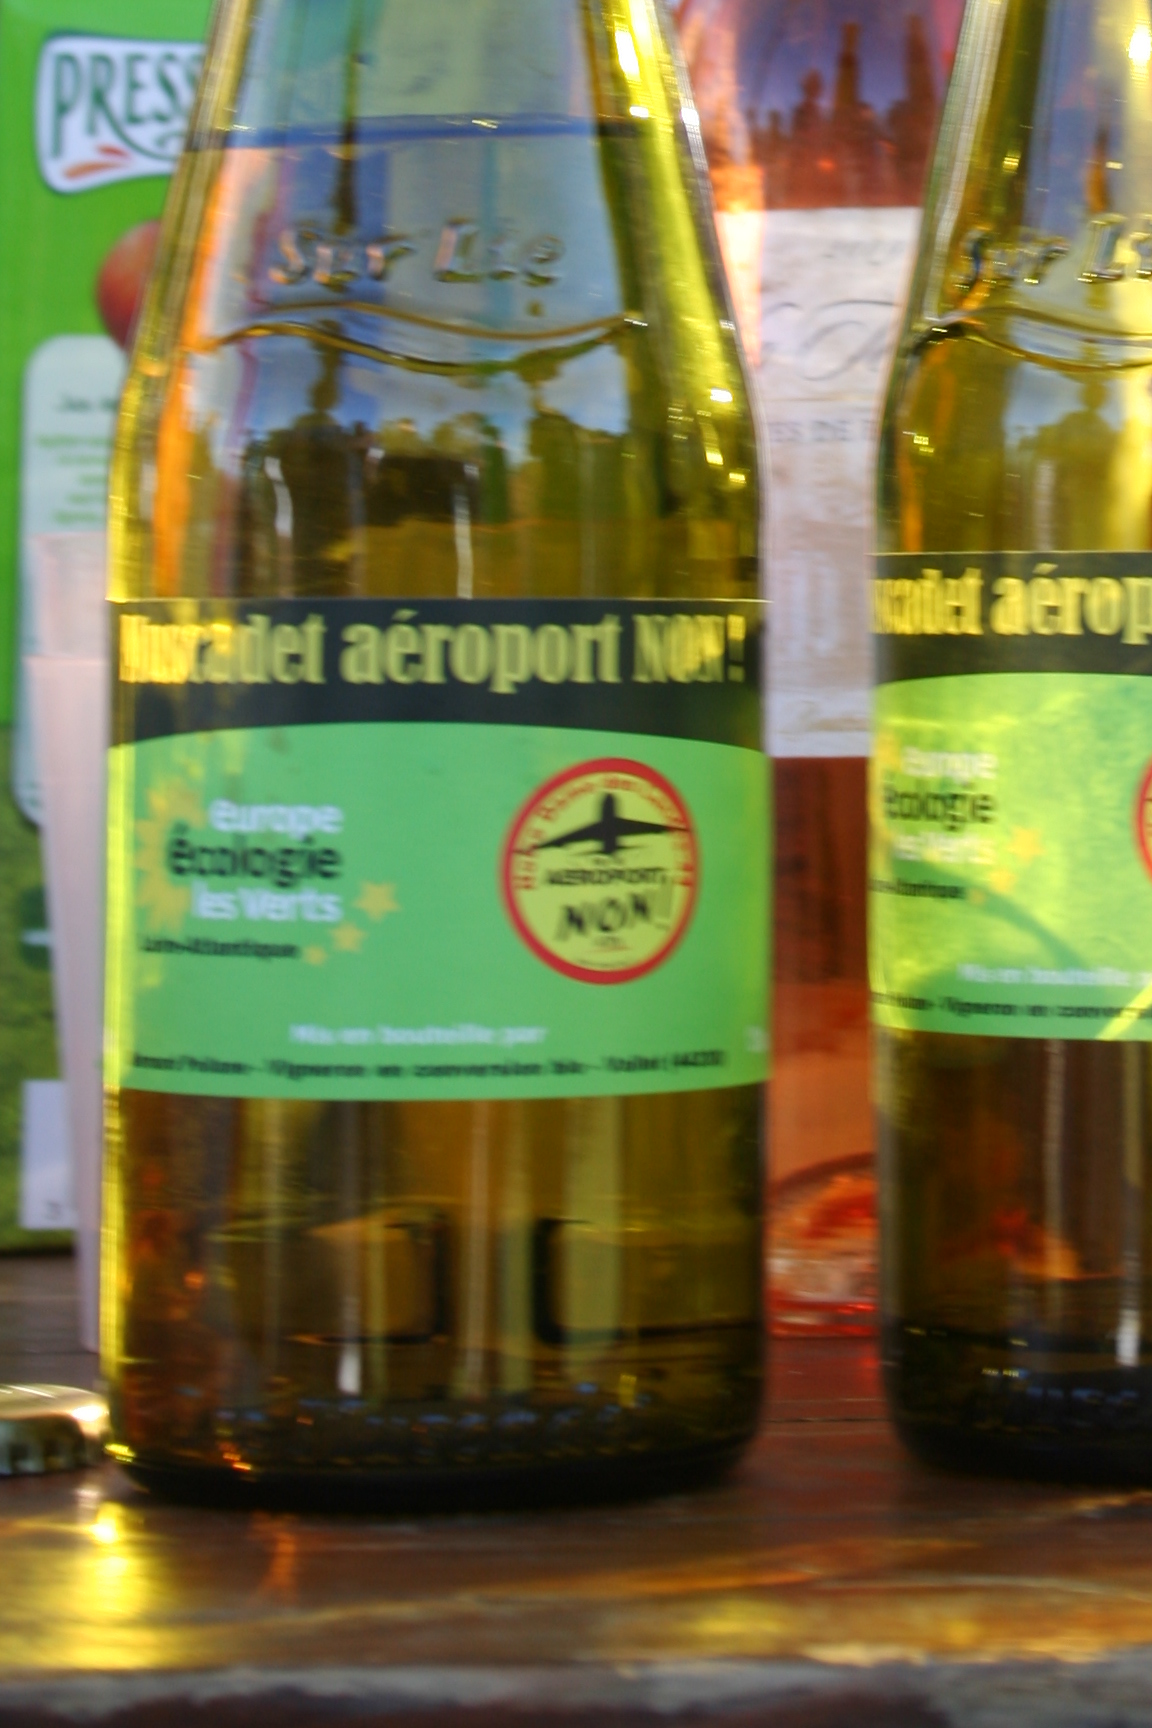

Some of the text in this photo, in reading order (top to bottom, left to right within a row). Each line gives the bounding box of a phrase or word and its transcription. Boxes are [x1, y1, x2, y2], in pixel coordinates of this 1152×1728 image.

[338, 608, 622, 694] aéroport
[208, 798, 344, 840] europe
[191, 878, 344, 922] les Verts
